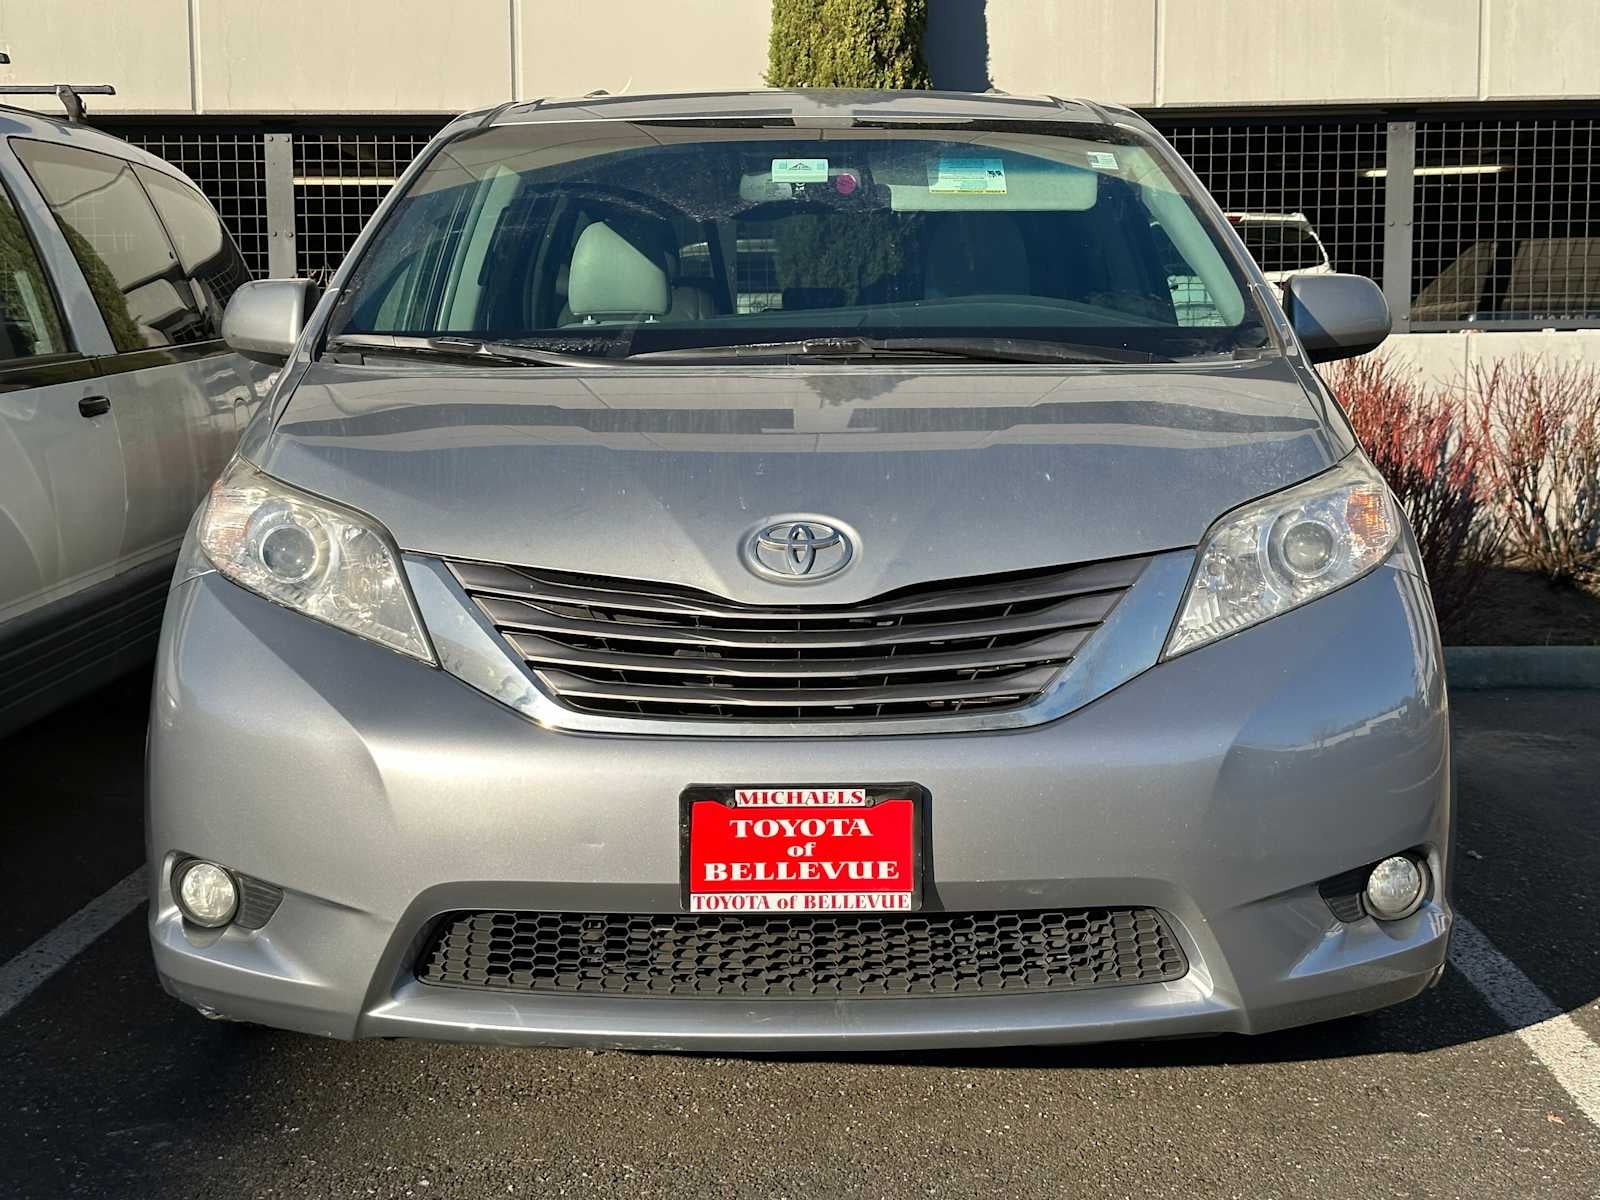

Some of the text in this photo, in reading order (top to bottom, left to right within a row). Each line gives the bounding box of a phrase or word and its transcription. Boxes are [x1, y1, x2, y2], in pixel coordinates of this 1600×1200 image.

[738, 791, 864, 805] MICHAELS
[729, 818, 873, 838] TOYOTA
[786, 842, 816, 857] of
[704, 861, 899, 881] BELLEVUE
[693, 894, 910, 910] TOYOTA of BELLEVUE
